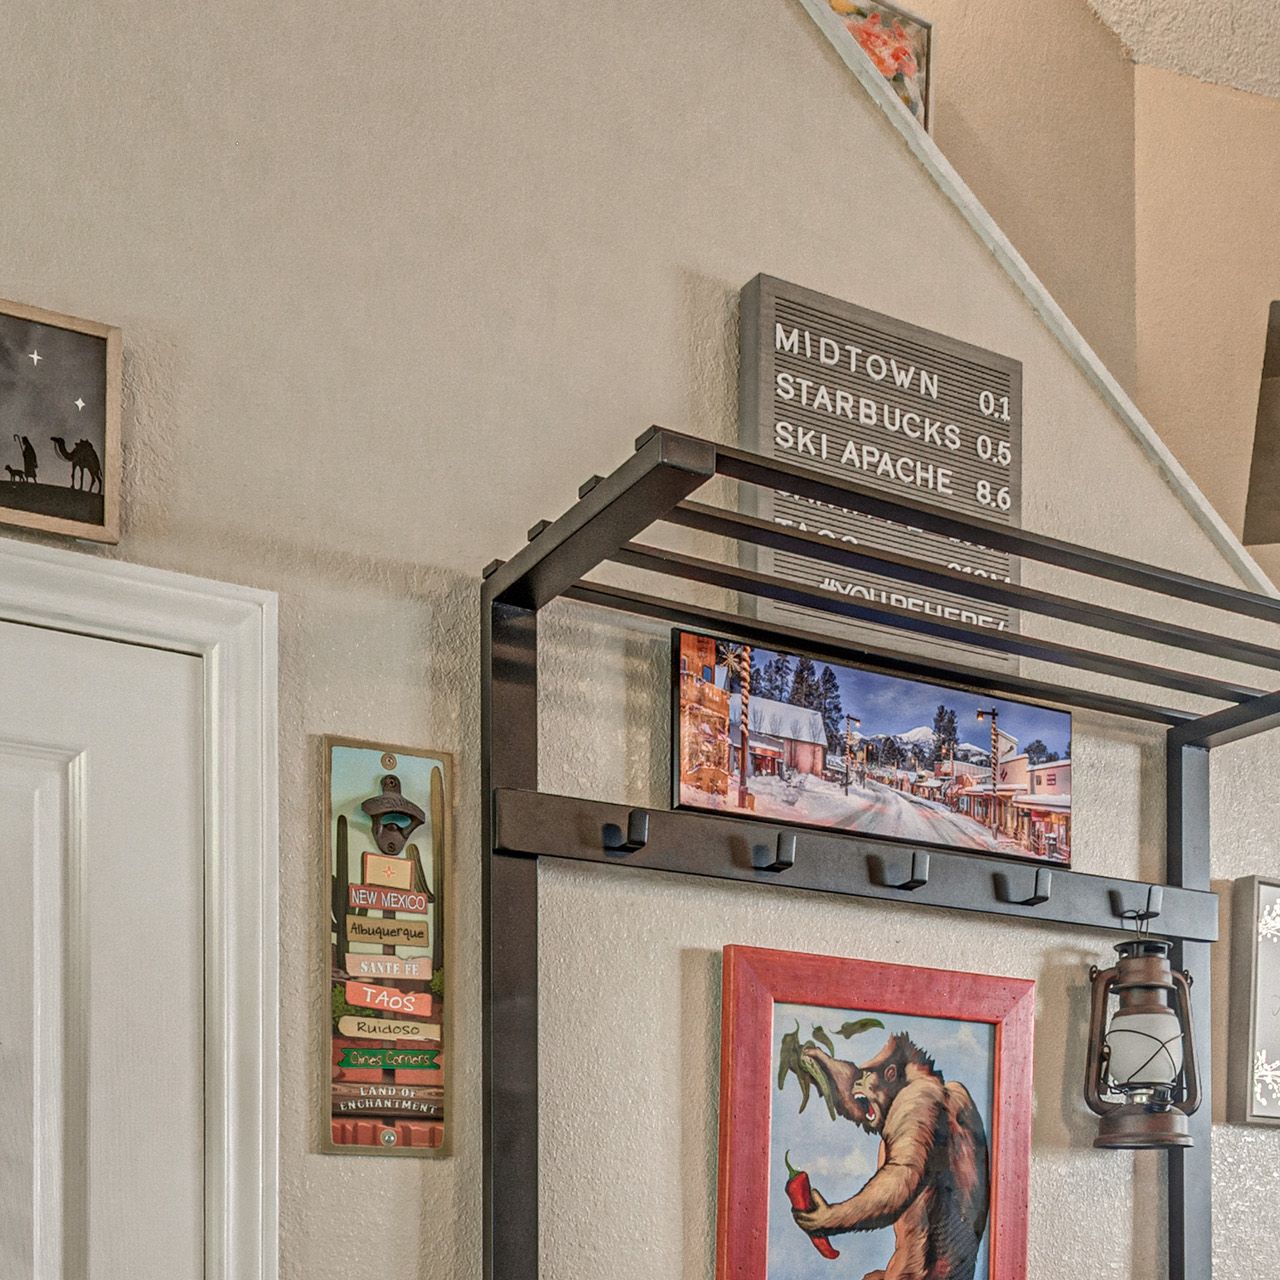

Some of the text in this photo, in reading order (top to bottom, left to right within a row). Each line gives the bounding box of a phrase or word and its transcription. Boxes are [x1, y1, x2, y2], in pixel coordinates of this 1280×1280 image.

[775, 322, 1011, 422] MIDTOWN 0.1
[775, 373, 1012, 467] STARBUCKS 0.5
[775, 421, 1012, 512] SKI APACHE 8.6
[351, 888, 426, 911] NEW MEXICO
[350, 921, 425, 941] Albuquerque
[404, 962, 420, 977] FE
[362, 986, 416, 1013] TAOS
[356, 1020, 420, 1037] Ruidoso
[386, 1051, 430, 1066] Corners
[360, 1086, 417, 1098] LAND OF
[340, 1098, 438, 1115] ENCHANTMENT
